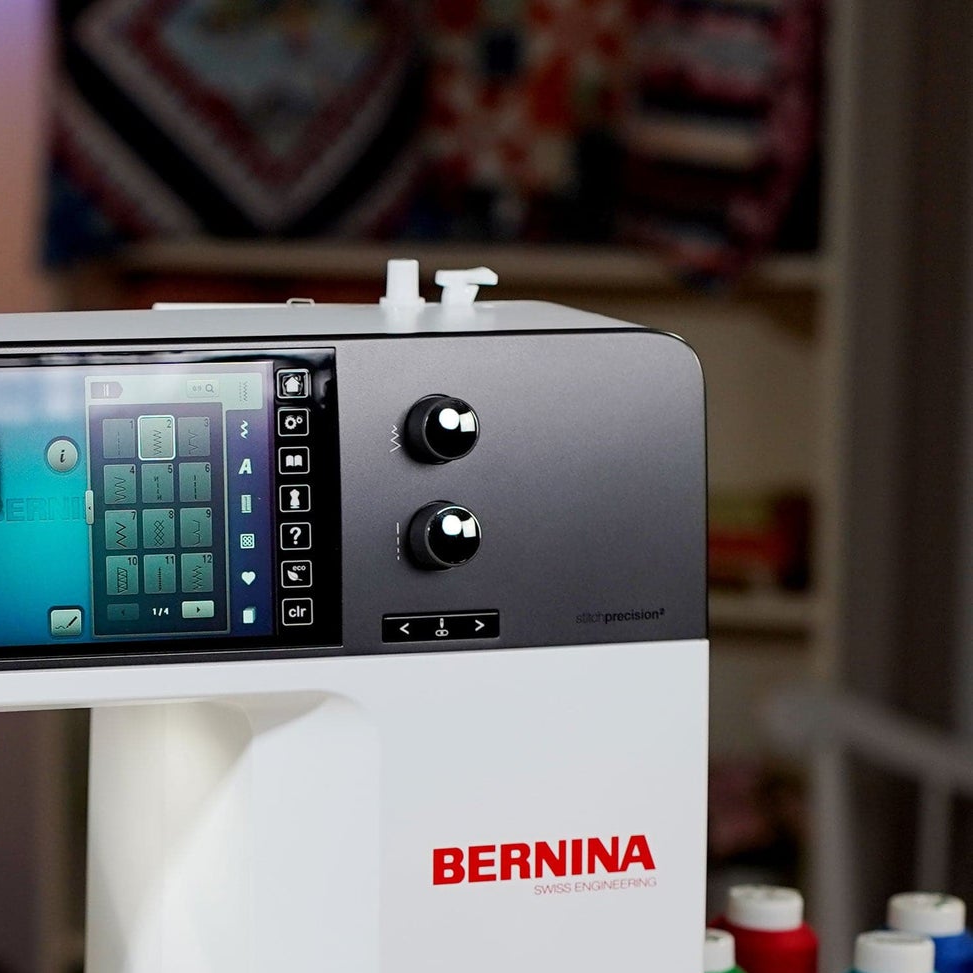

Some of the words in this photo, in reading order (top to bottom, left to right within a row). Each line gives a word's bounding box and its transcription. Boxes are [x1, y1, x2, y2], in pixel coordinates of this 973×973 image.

[129, 420, 134, 429] 1
[166, 419, 172, 429] 2
[204, 418, 209, 427] 3
[129, 466, 135, 475] 4
[167, 465, 173, 474] 5
[205, 464, 210, 473] 6
[238, 458, 252, 475] A
[131, 511, 136, 520] 7
[168, 510, 174, 519] 8
[206, 509, 211, 518] 9
[127, 557, 138, 566] 10
[165, 556, 175, 565] 11
[202, 554, 212, 564] 12
[292, 564, 306, 572] eco
[152, 606, 169, 616] 1/4
[288, 604, 307, 618] clr
[432, 834, 656, 885] BERNINA
[534, 882, 572, 896] SWISS
[575, 877, 657, 893] ENGINEERING
